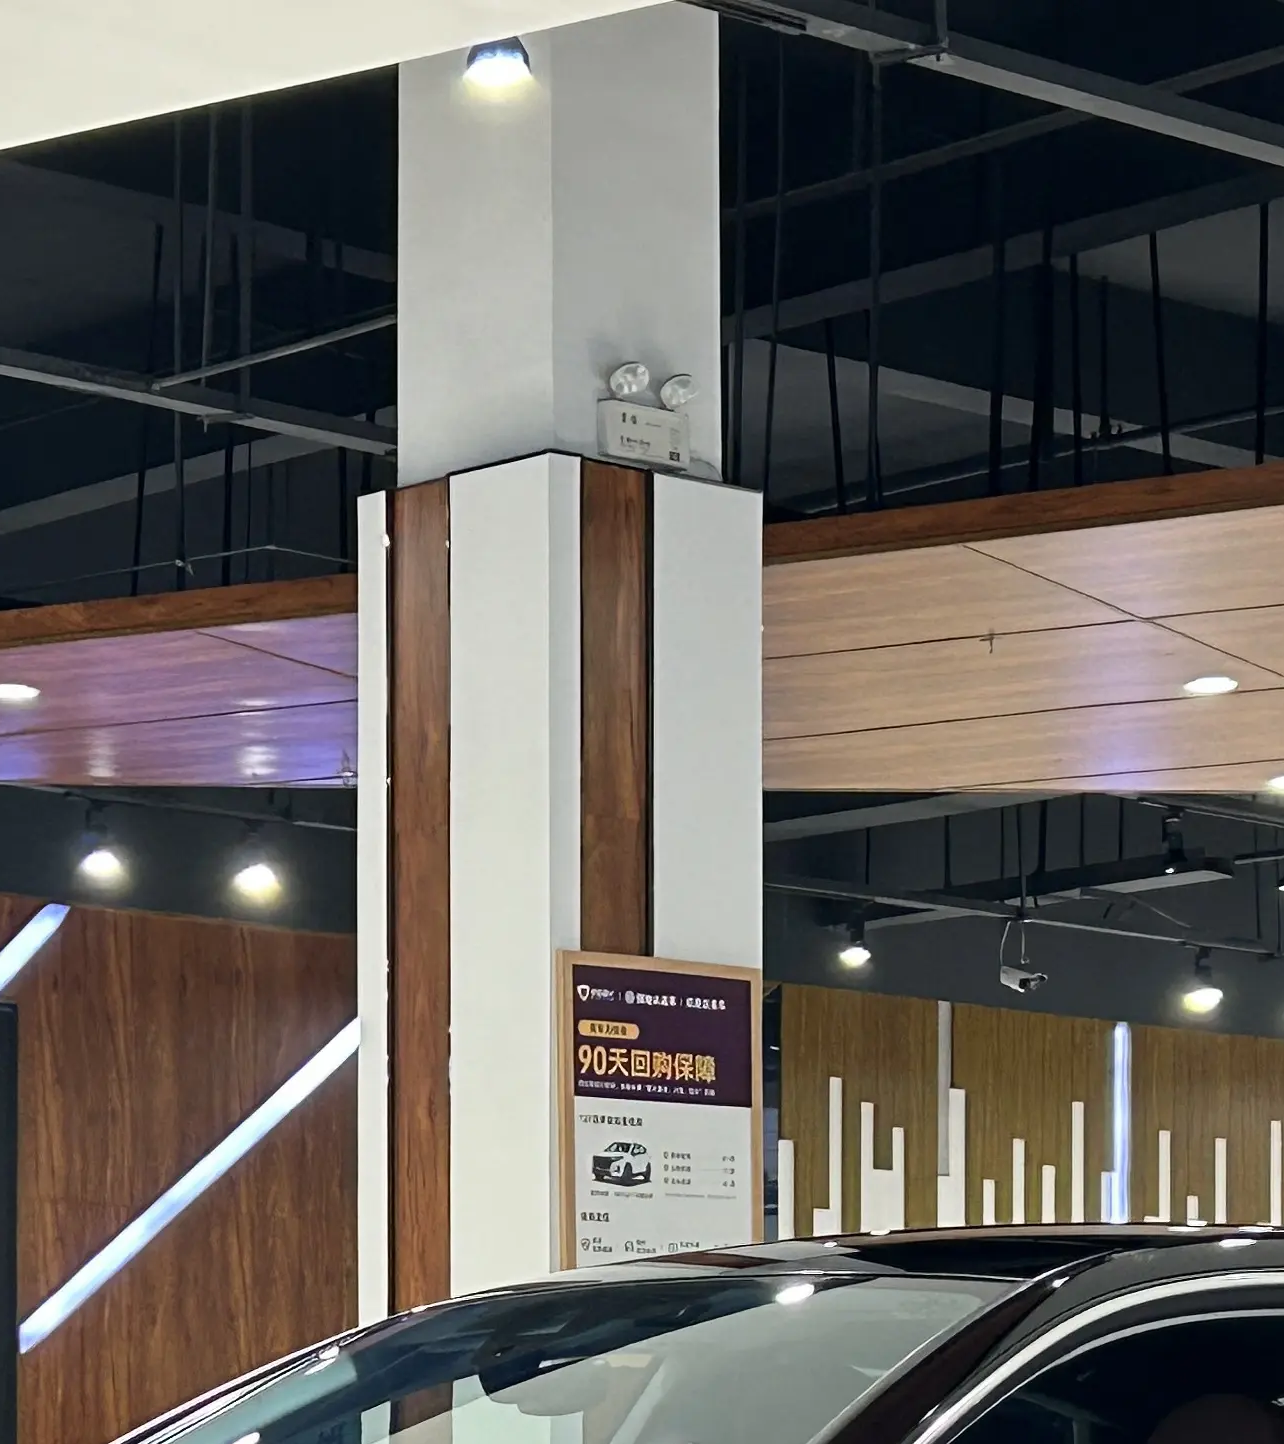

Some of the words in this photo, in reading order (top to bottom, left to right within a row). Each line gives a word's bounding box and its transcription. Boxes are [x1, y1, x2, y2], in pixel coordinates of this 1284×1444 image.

[578, 1044, 716, 1083] 90天回购保障
